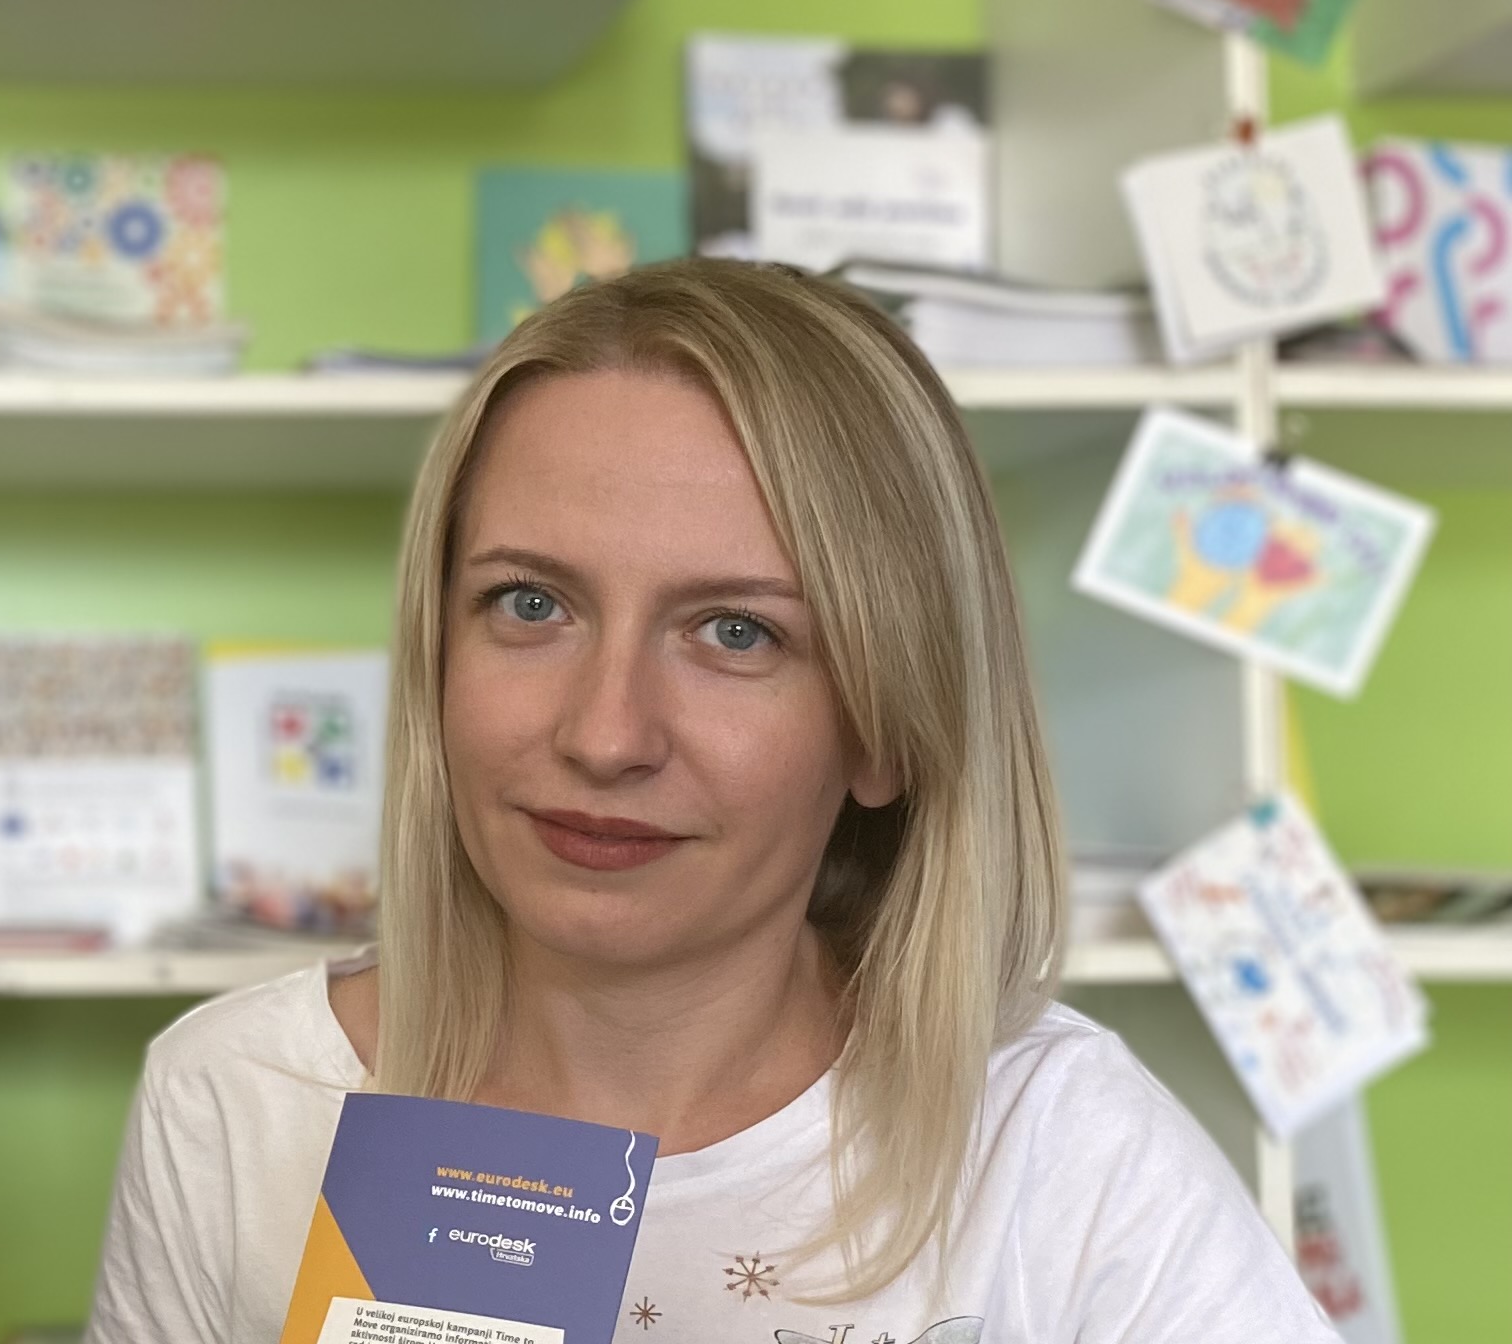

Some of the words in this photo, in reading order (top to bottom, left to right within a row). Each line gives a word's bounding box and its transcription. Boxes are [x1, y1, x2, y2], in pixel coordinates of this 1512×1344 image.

[436, 1166, 573, 1198] www.eurodesk.eu
[431, 1185, 601, 1224] www.timetomove.info
[448, 1228, 537, 1254] eurodesk
[350, 1328, 396, 1344] aktivnosti
[352, 1317, 378, 1330] Move
[379, 1323, 443, 1341] organiziramo
[355, 1306, 364, 1316] U
[364, 1309, 395, 1323] velikoj
[396, 1315, 444, 1331] europskoj
[445, 1320, 492, 1340] kampanji
[495, 1330, 521, 1344] Time
